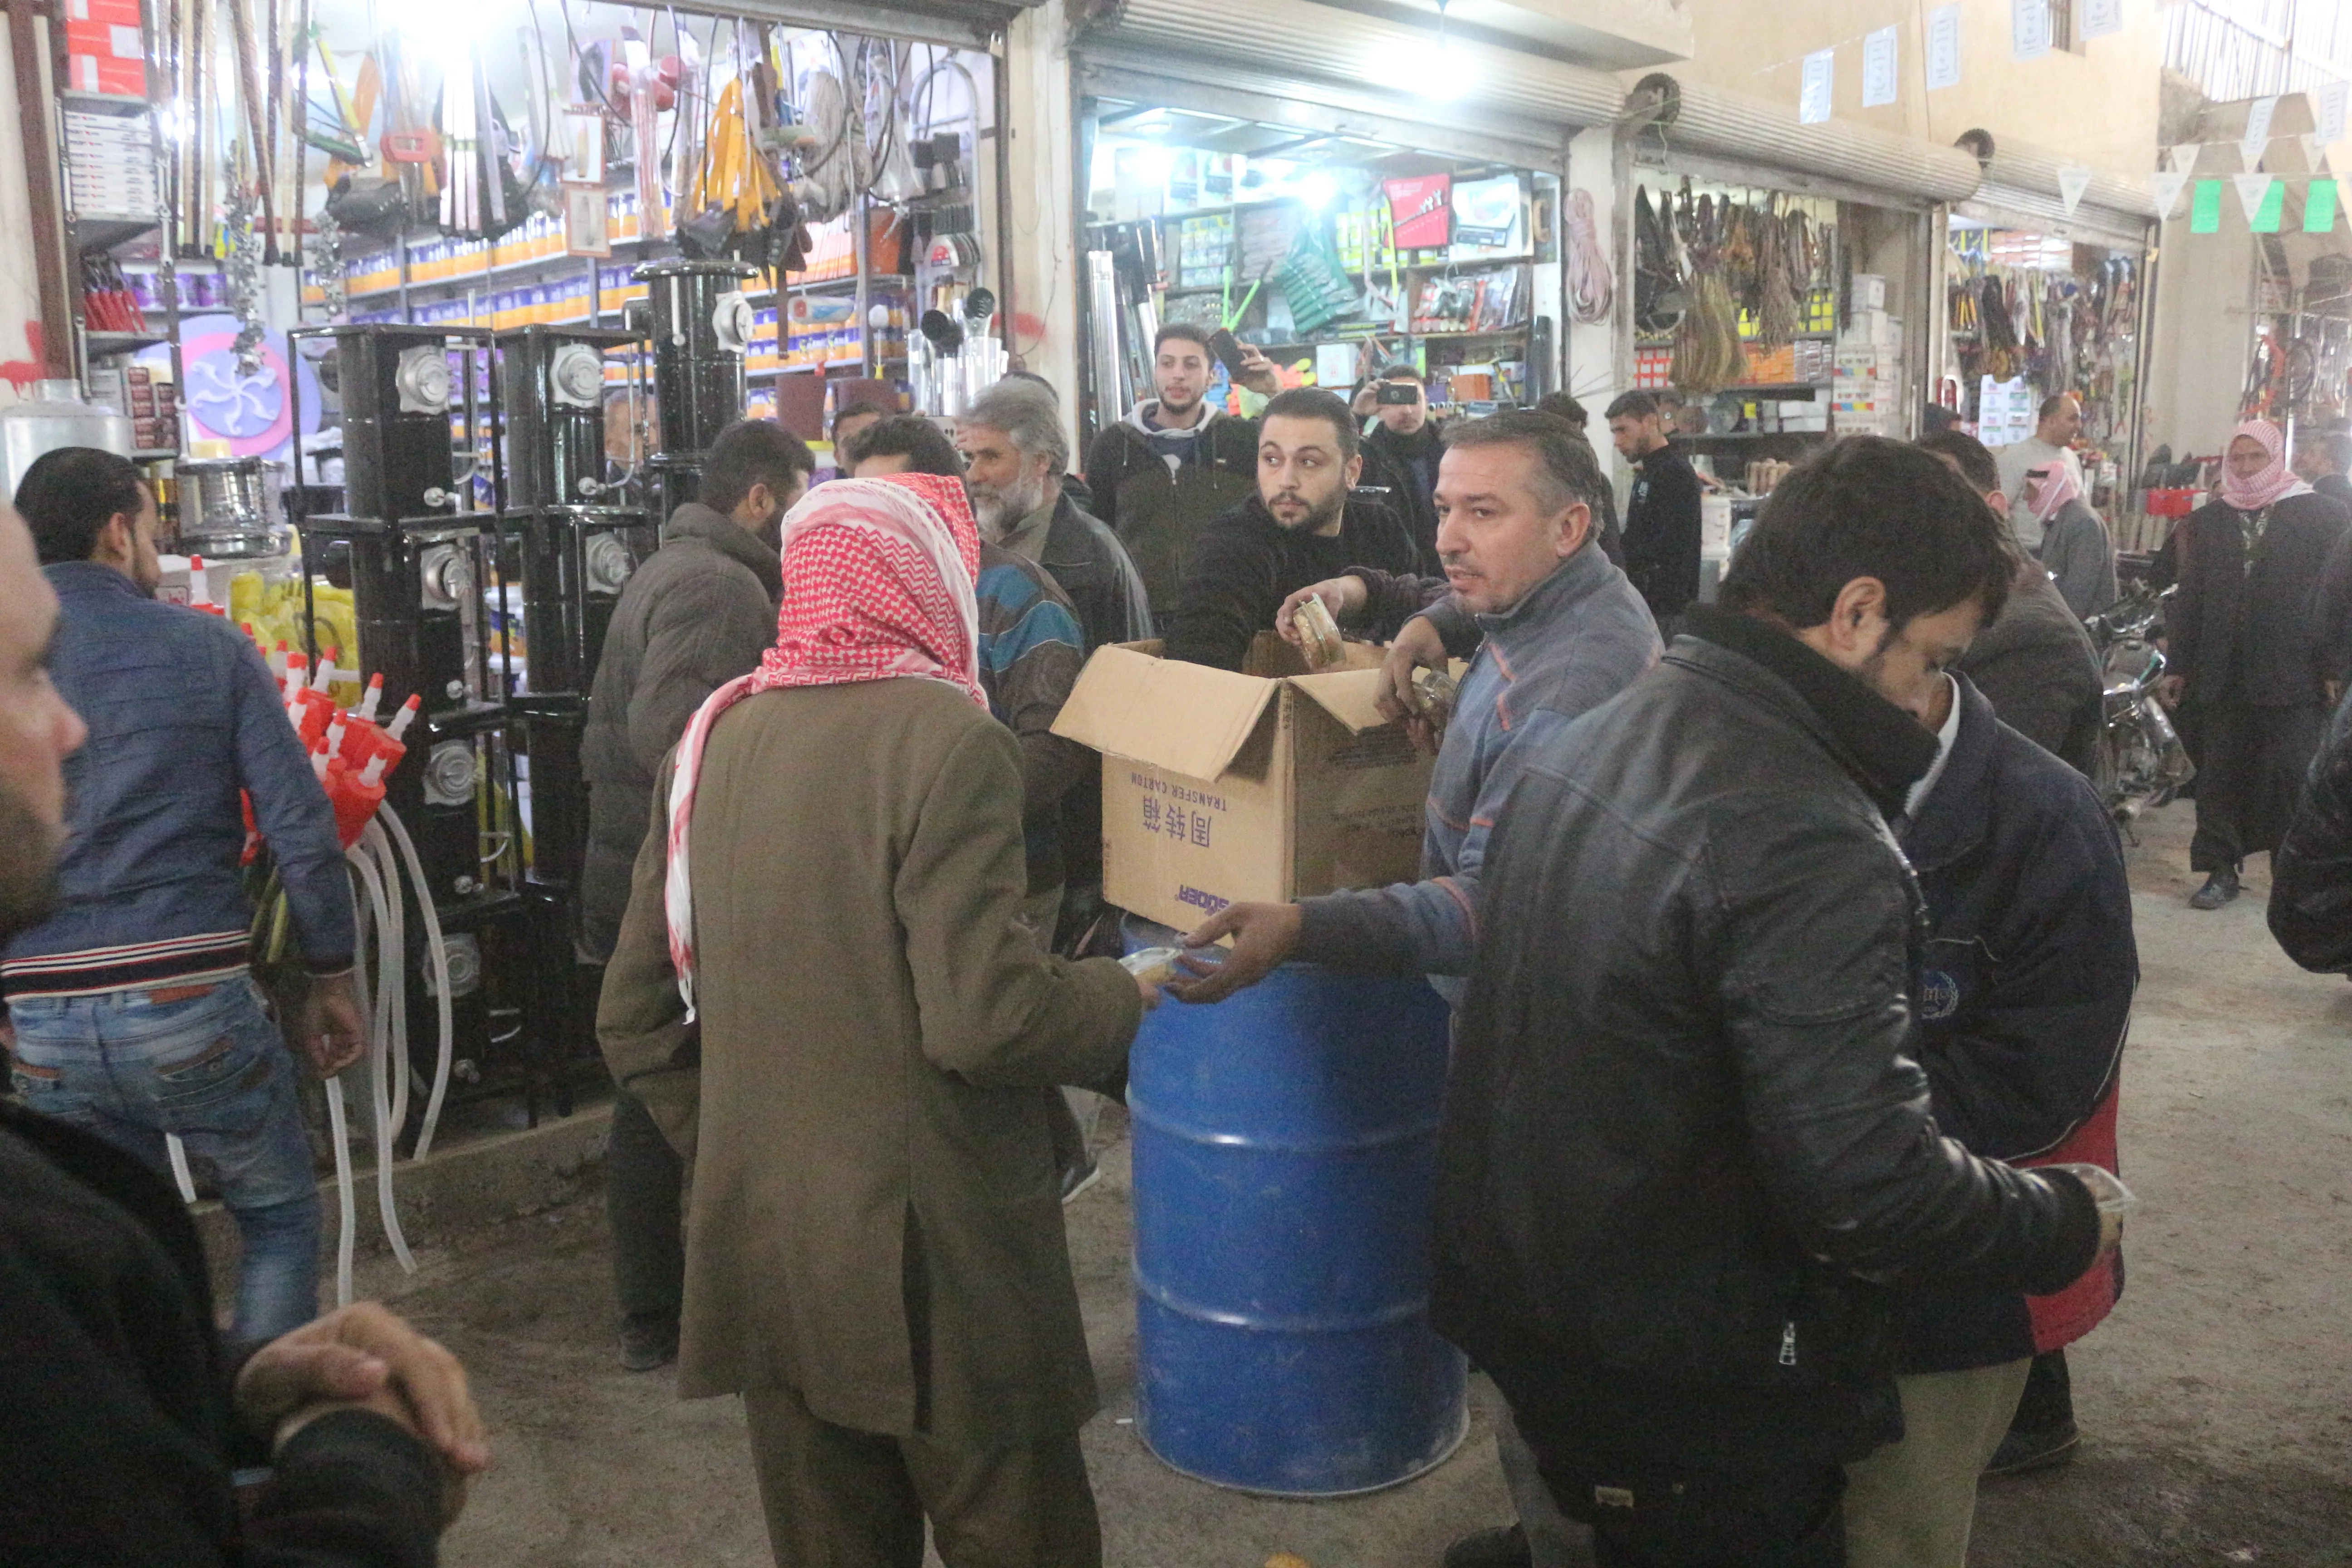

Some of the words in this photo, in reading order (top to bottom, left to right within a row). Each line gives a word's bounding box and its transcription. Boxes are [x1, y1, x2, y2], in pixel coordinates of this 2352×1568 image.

[1132, 772, 1167, 794] CARTON
[1172, 784, 1227, 812] TRANSFER
[1142, 795, 1211, 848] 周转箱
